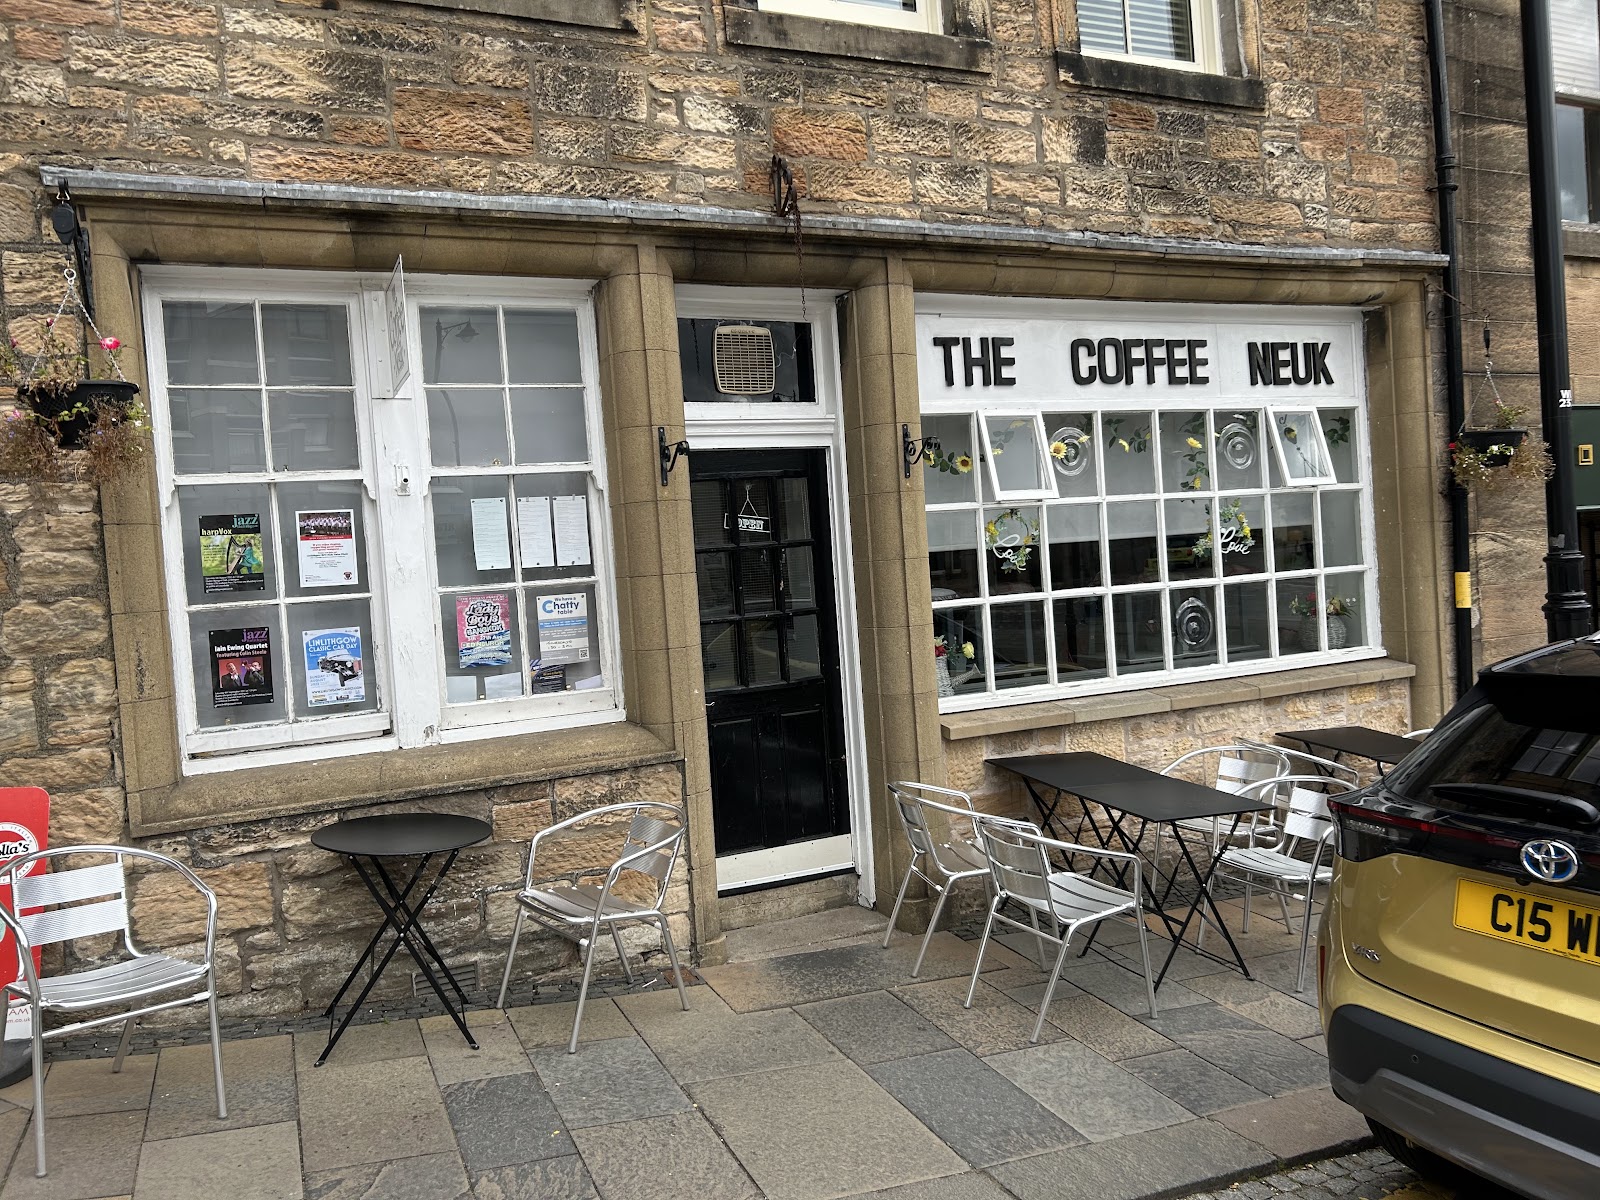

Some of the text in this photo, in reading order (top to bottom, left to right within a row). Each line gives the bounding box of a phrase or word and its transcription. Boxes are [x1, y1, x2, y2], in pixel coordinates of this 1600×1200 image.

[933, 336, 1335, 386] THE COFFEE NEUK
[232, 514, 258, 528] jazz
[201, 528, 232, 536] harpVox
[466, 603, 499, 616] Lady
[542, 600, 579, 614] Chatty
[468, 614, 498, 626] Boys
[241, 629, 268, 642] jazz
[467, 623, 503, 636] BANGKOK
[308, 636, 357, 647] LINLITHGOW
[308, 645, 331, 653] CLASSIC
[1491, 893, 1554, 942] C15
[9, 1008, 28, 1016] AM
